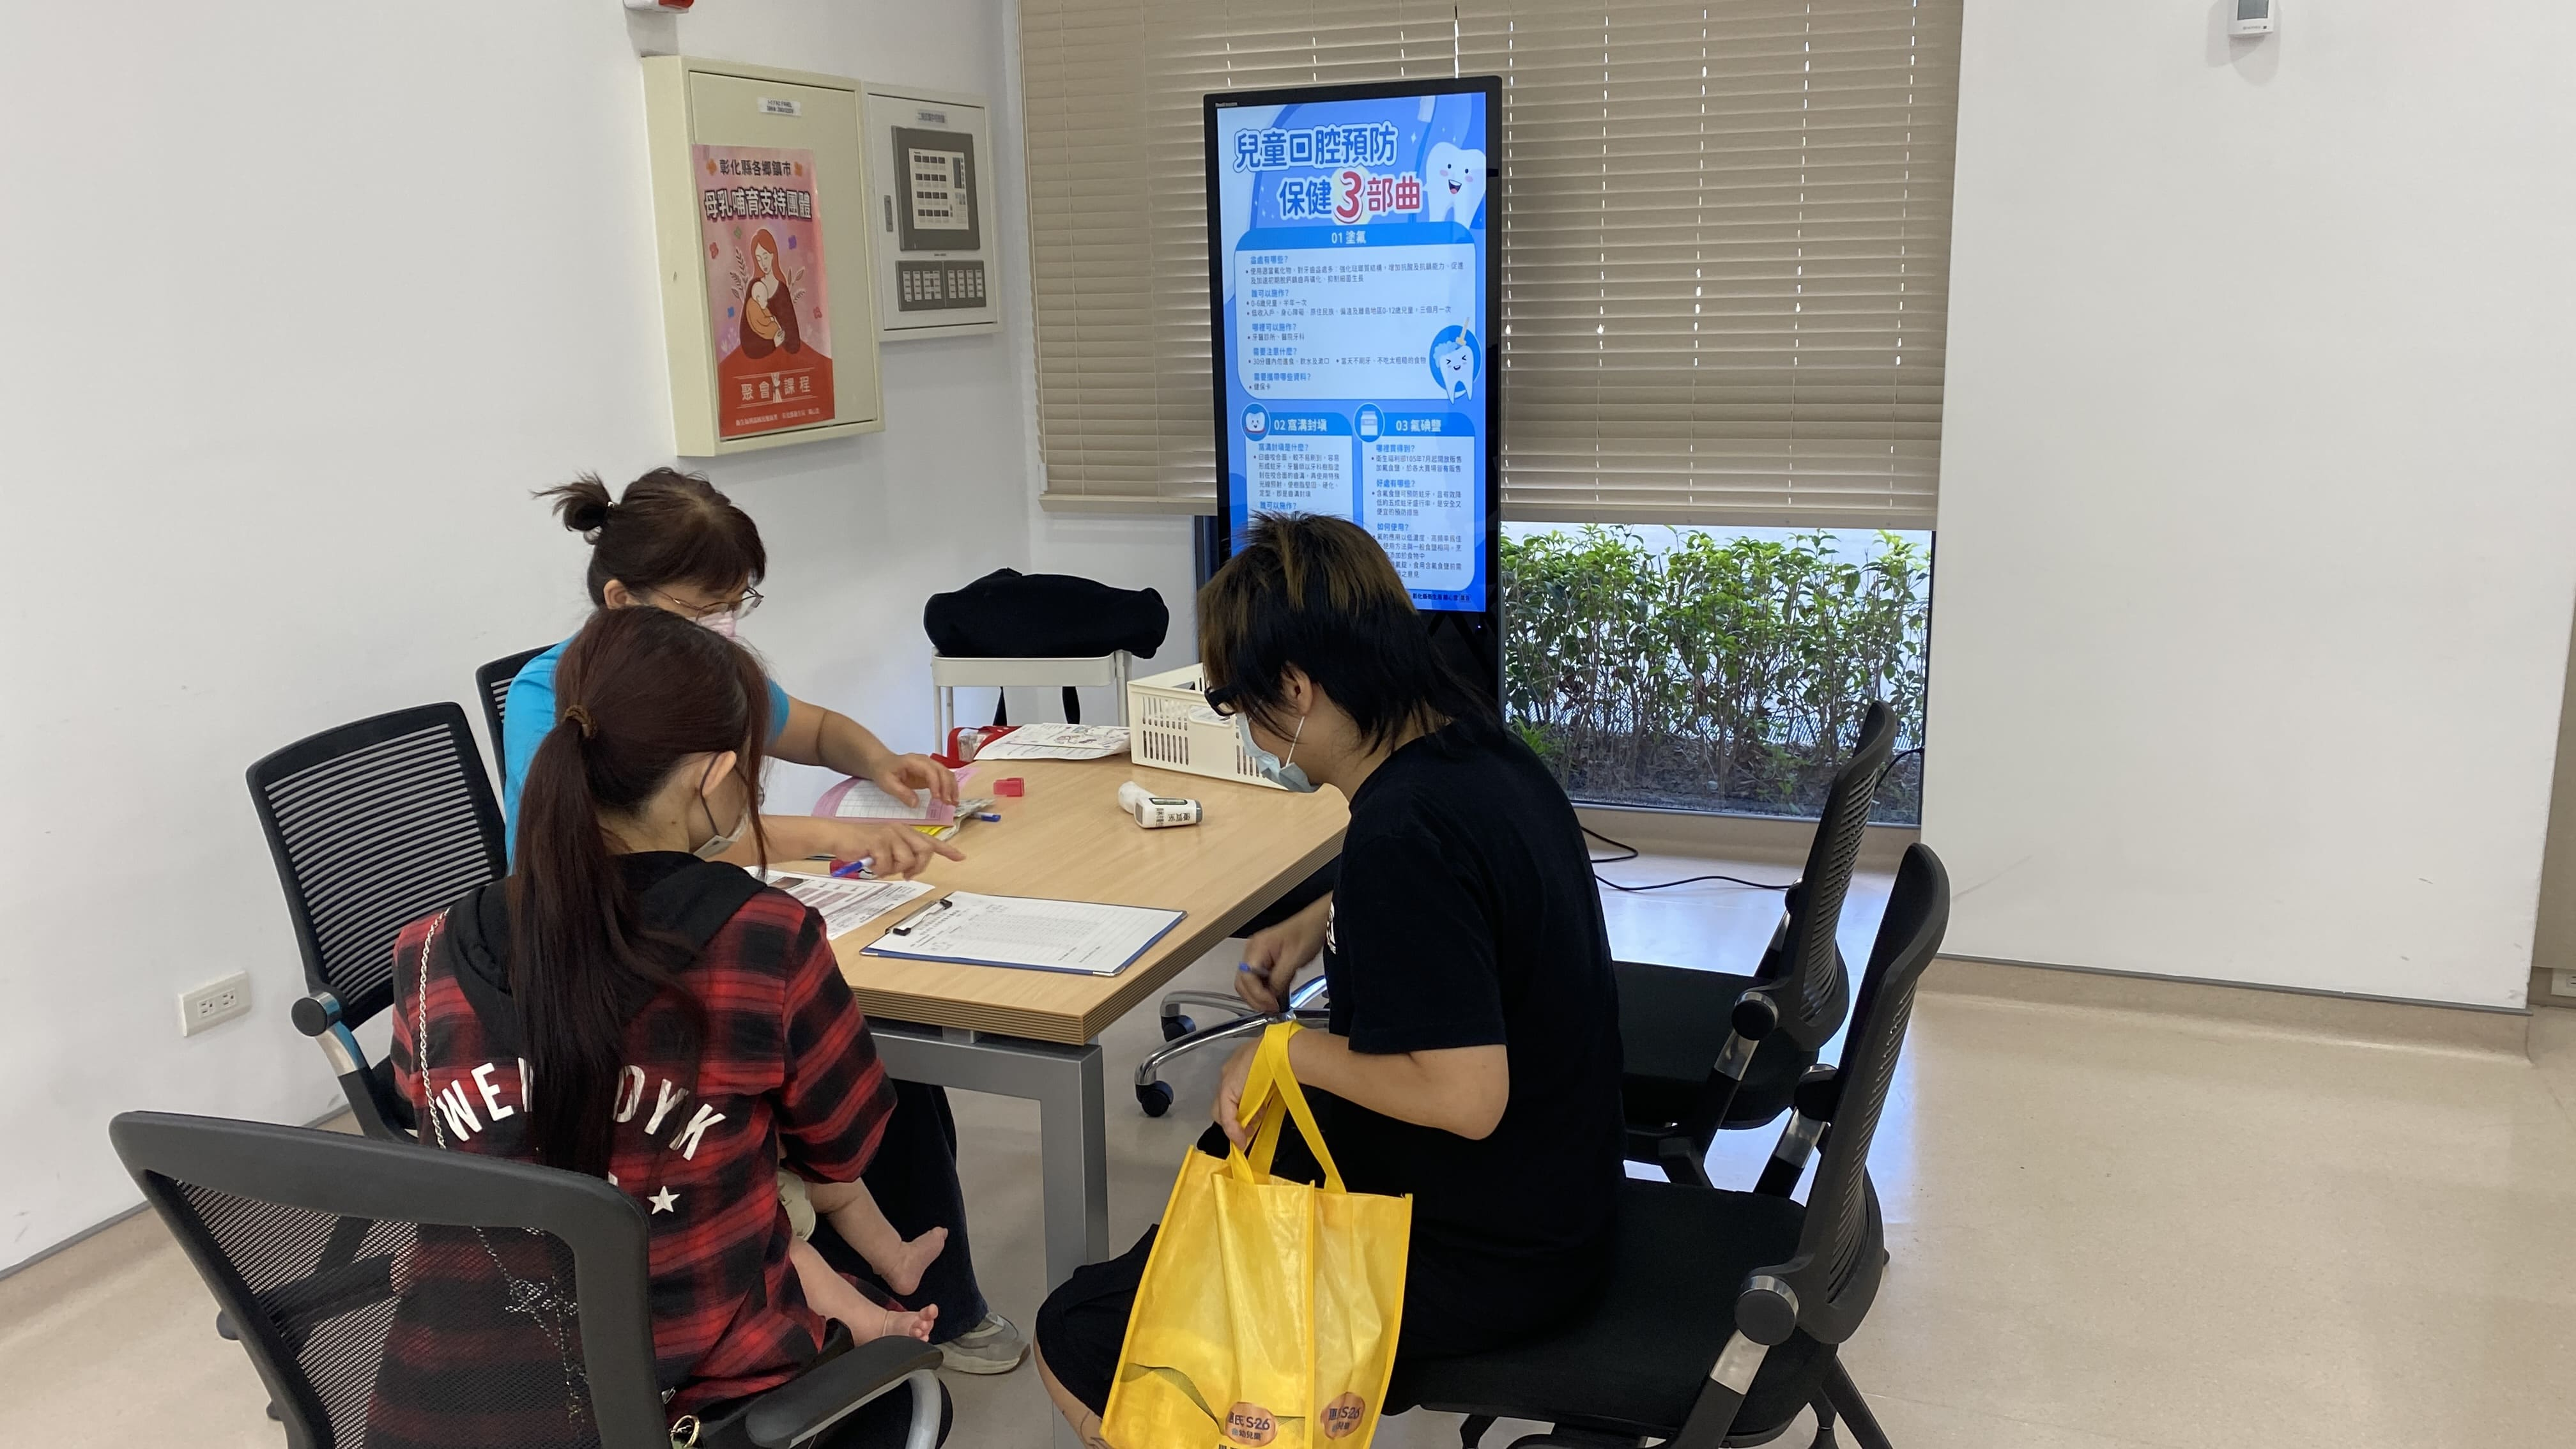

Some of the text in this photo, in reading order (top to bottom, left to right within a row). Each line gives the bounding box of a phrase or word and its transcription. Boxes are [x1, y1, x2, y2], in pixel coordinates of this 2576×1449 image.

[1236, 126, 1395, 168] 兒童口腔預防
[719, 159, 792, 177] 彰化縣各鄉鎮市
[704, 187, 811, 219] 母乳哺育支持團體
[1279, 171, 1420, 218] 保健3部曲
[1331, 230, 1367, 244] 01 塗氟
[741, 376, 811, 401] 聚會 課程
[1274, 420, 1285, 431] 02
[1396, 420, 1408, 431] 03
[1246, 1416, 1271, 1431] S-26
